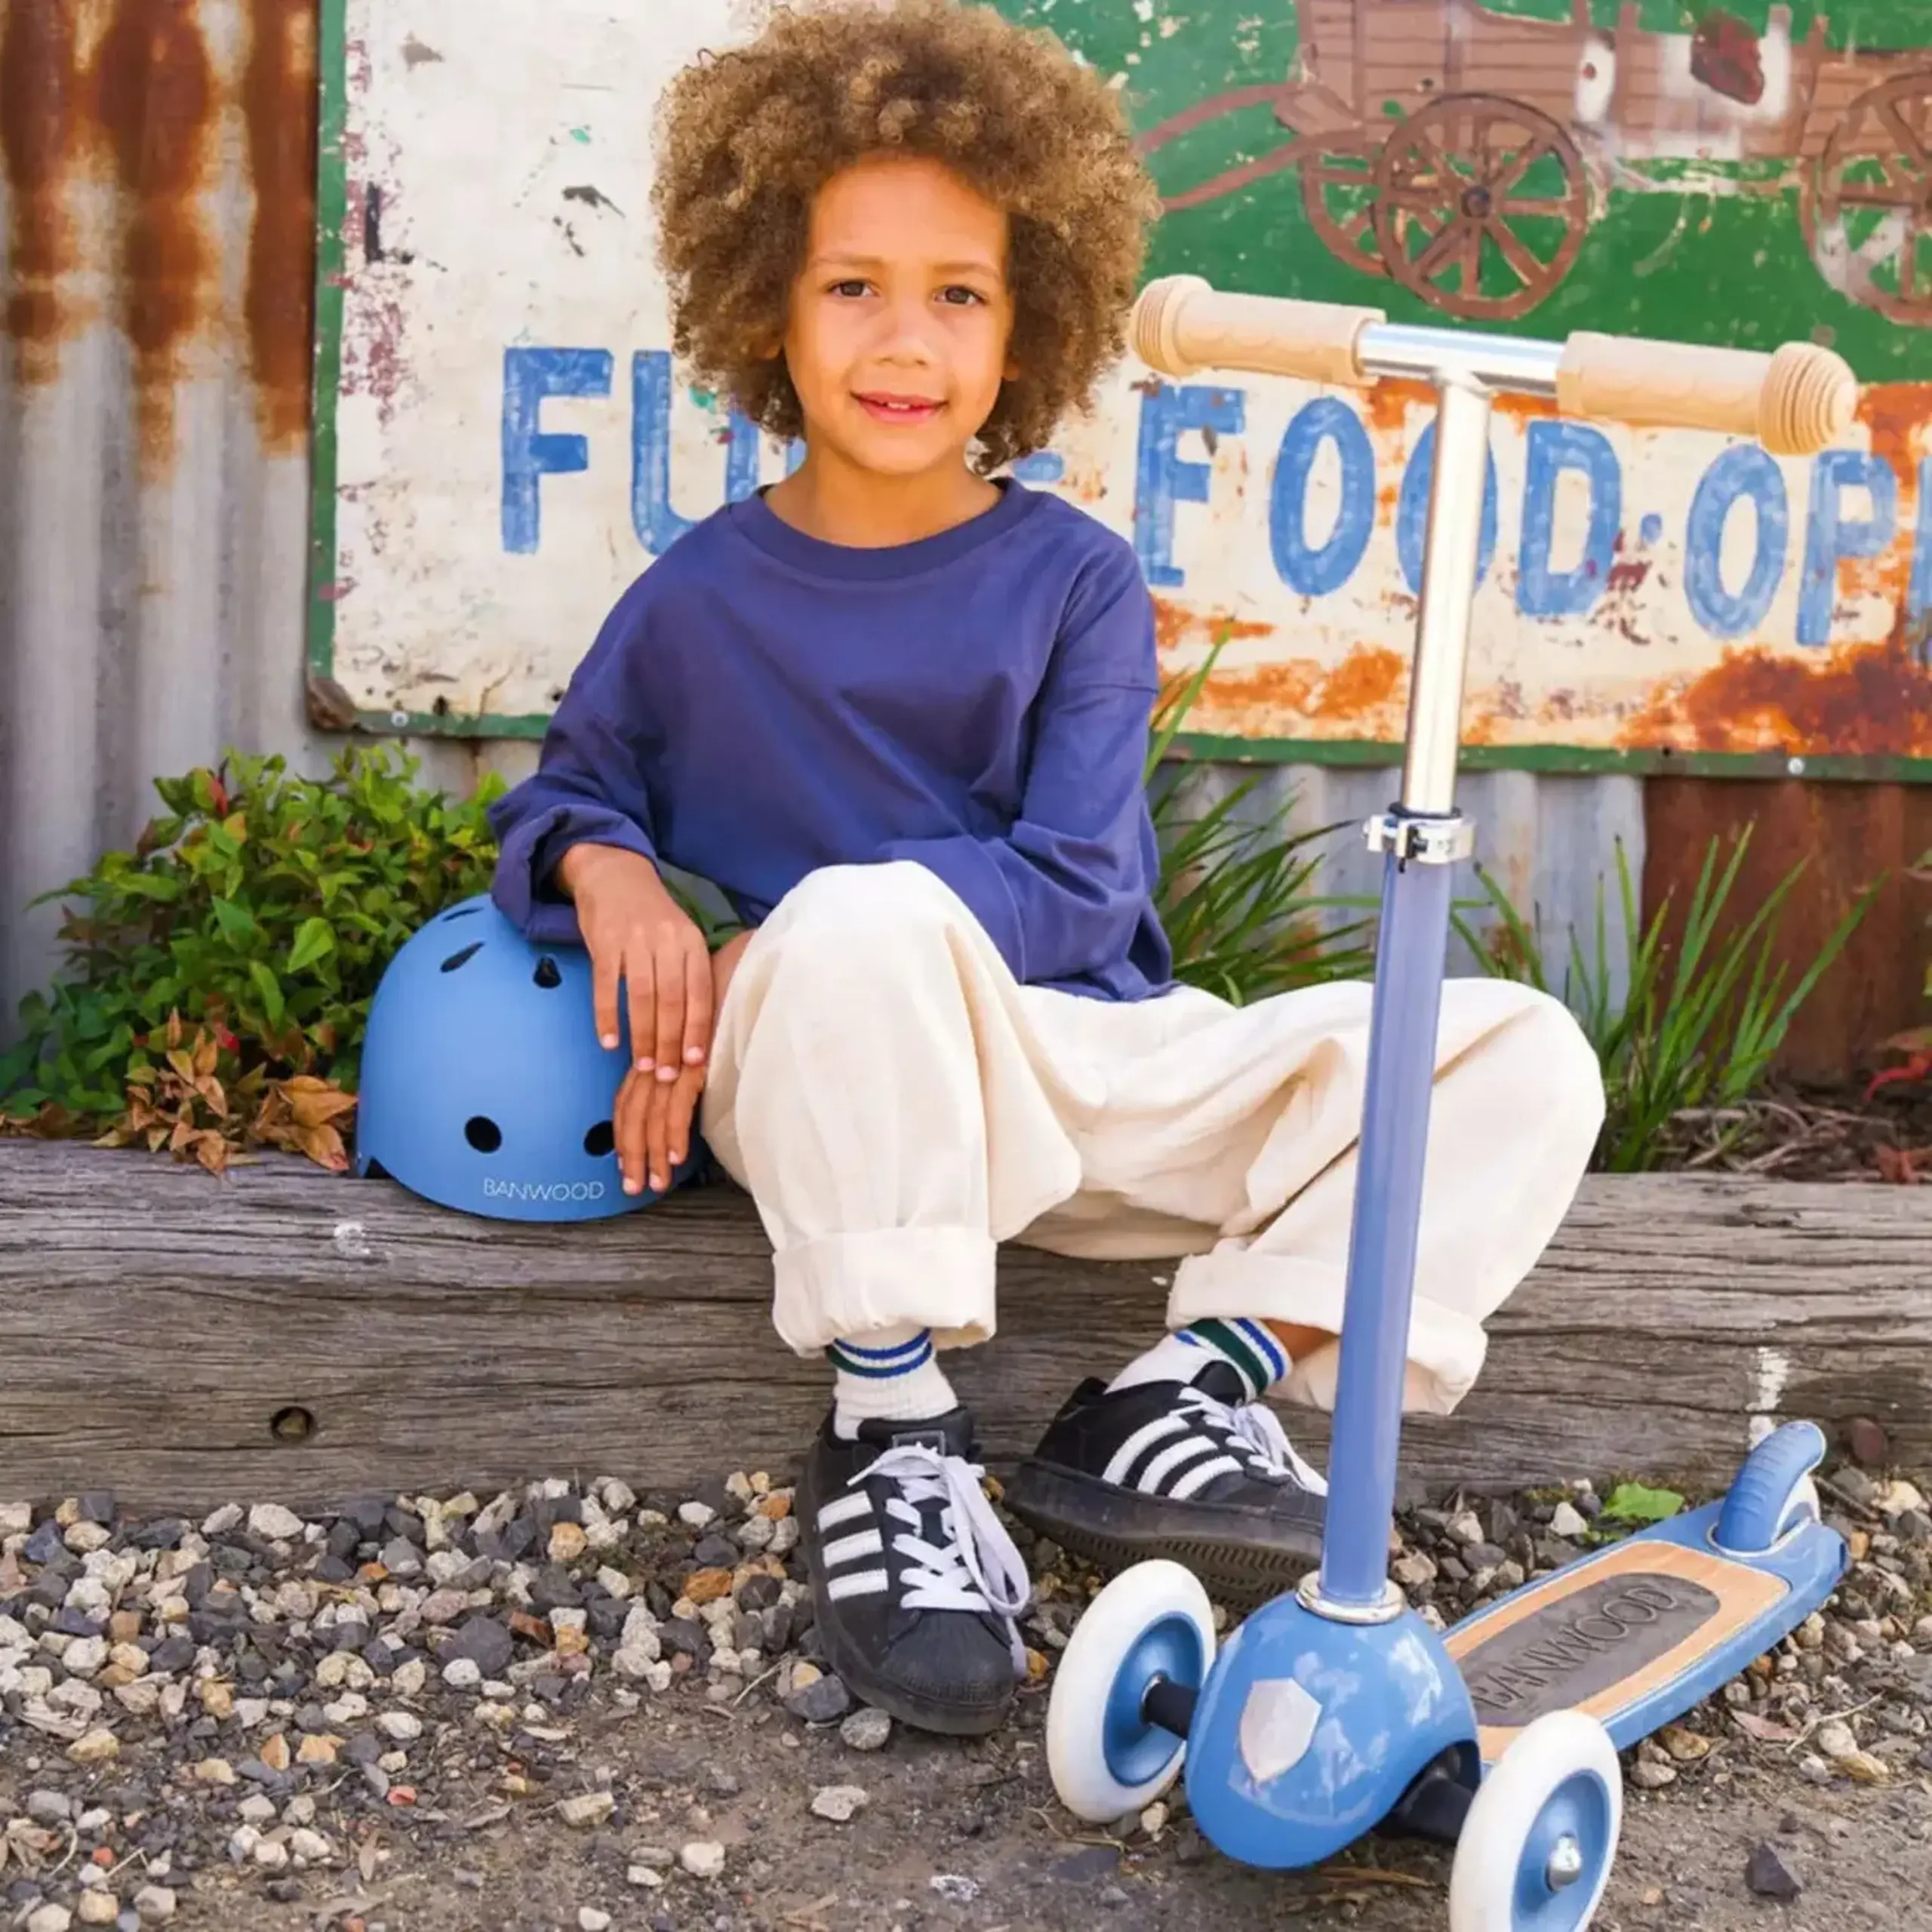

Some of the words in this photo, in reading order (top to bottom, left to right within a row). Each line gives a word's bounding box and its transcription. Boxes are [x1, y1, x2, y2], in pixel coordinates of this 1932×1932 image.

[1683, 442, 1932, 651] OP
[483, 1177, 605, 1201] BANWOOD
[1469, 1587, 1678, 1711] BANWOOD
